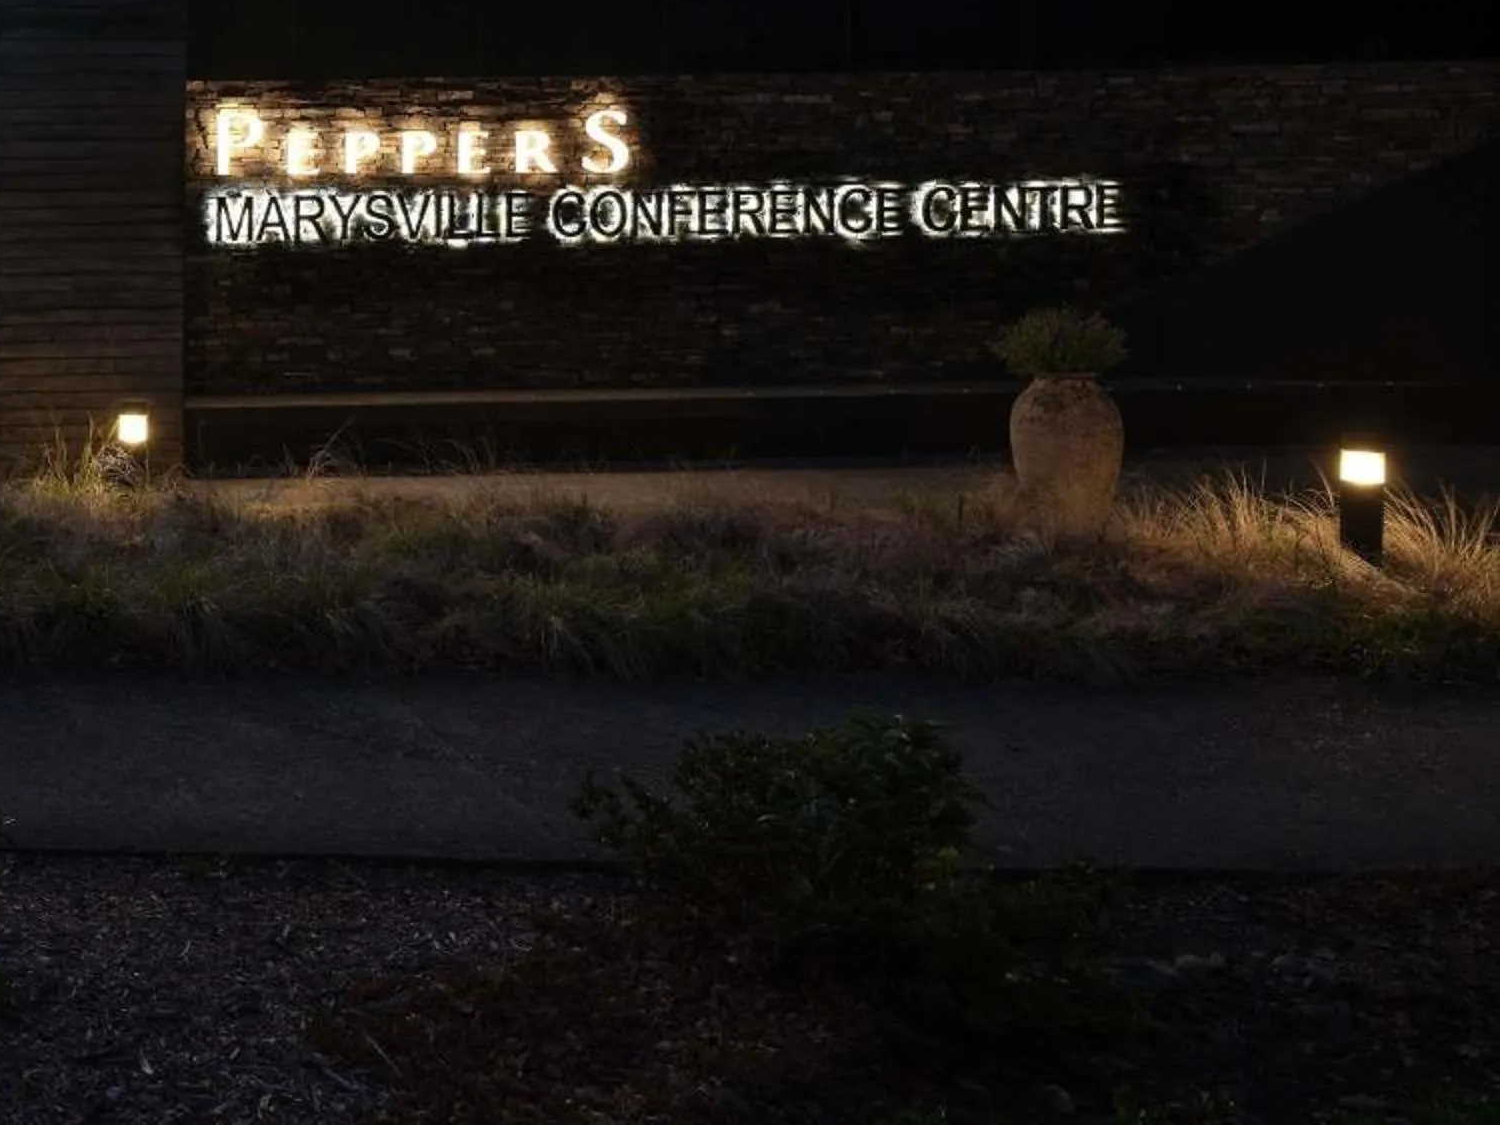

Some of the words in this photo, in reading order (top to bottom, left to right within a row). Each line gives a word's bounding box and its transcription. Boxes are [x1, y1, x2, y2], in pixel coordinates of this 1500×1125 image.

[216, 109, 630, 175] PEPPERS
[215, 192, 531, 242] MARYSVILLE
[552, 186, 901, 238] CONFERENCE
[921, 184, 1126, 233] CENTRE
